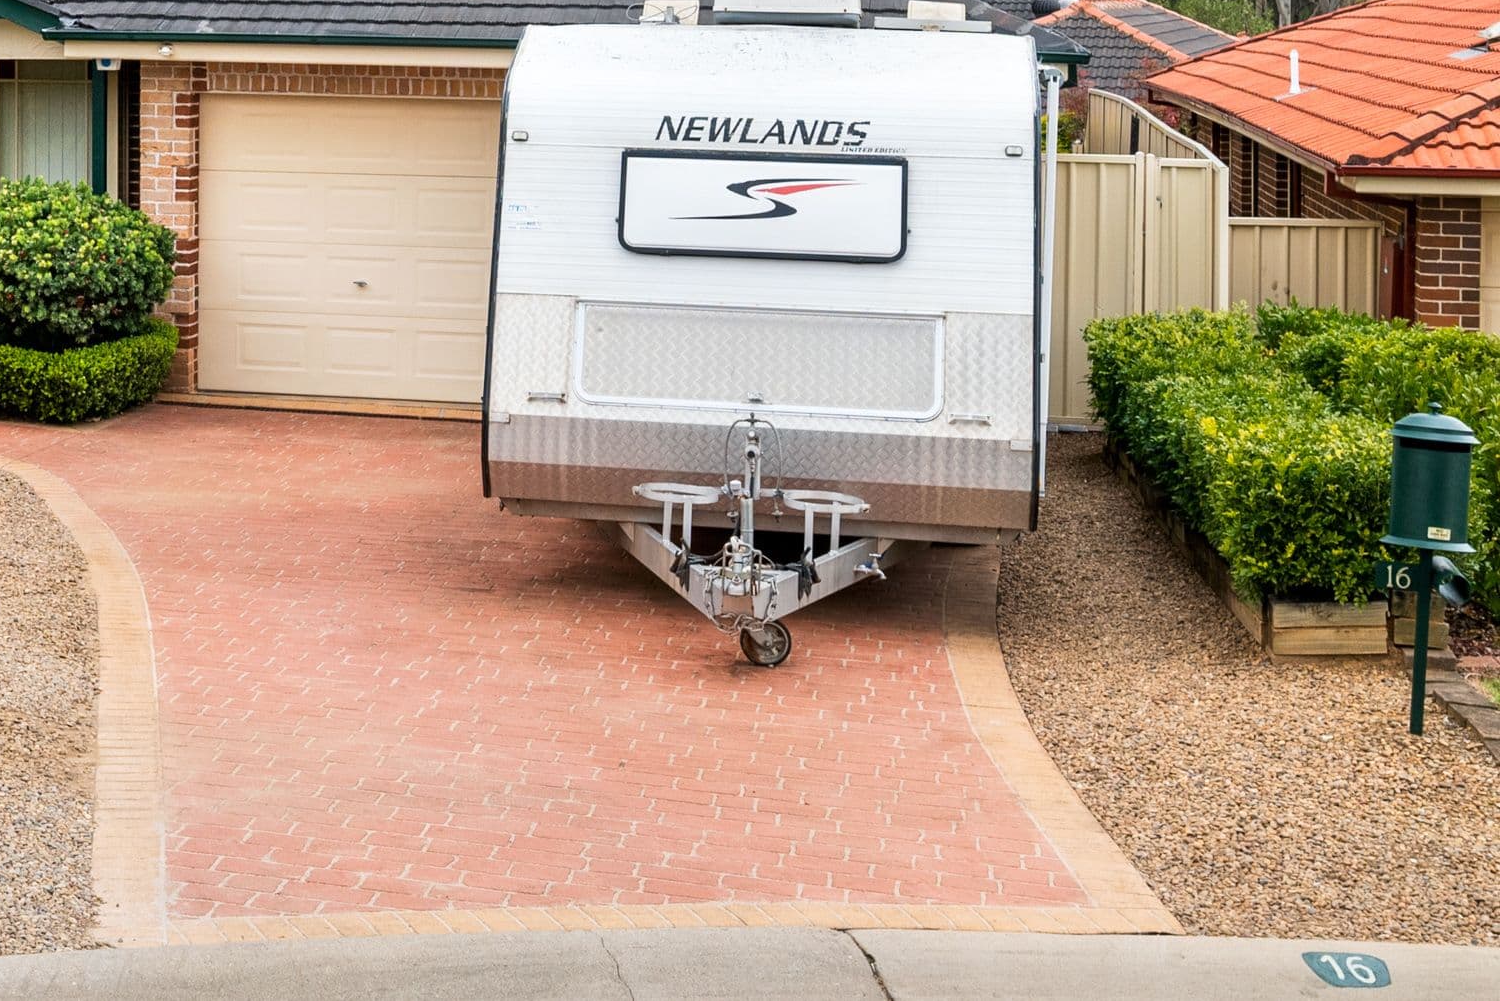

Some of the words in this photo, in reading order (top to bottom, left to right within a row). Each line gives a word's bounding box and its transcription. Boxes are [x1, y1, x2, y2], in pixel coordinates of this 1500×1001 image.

[655, 115, 871, 147] NEWLANDS
[840, 146, 873, 154] LIMITED
[1386, 565, 1411, 589] 16
[1320, 955, 1376, 984] 16
